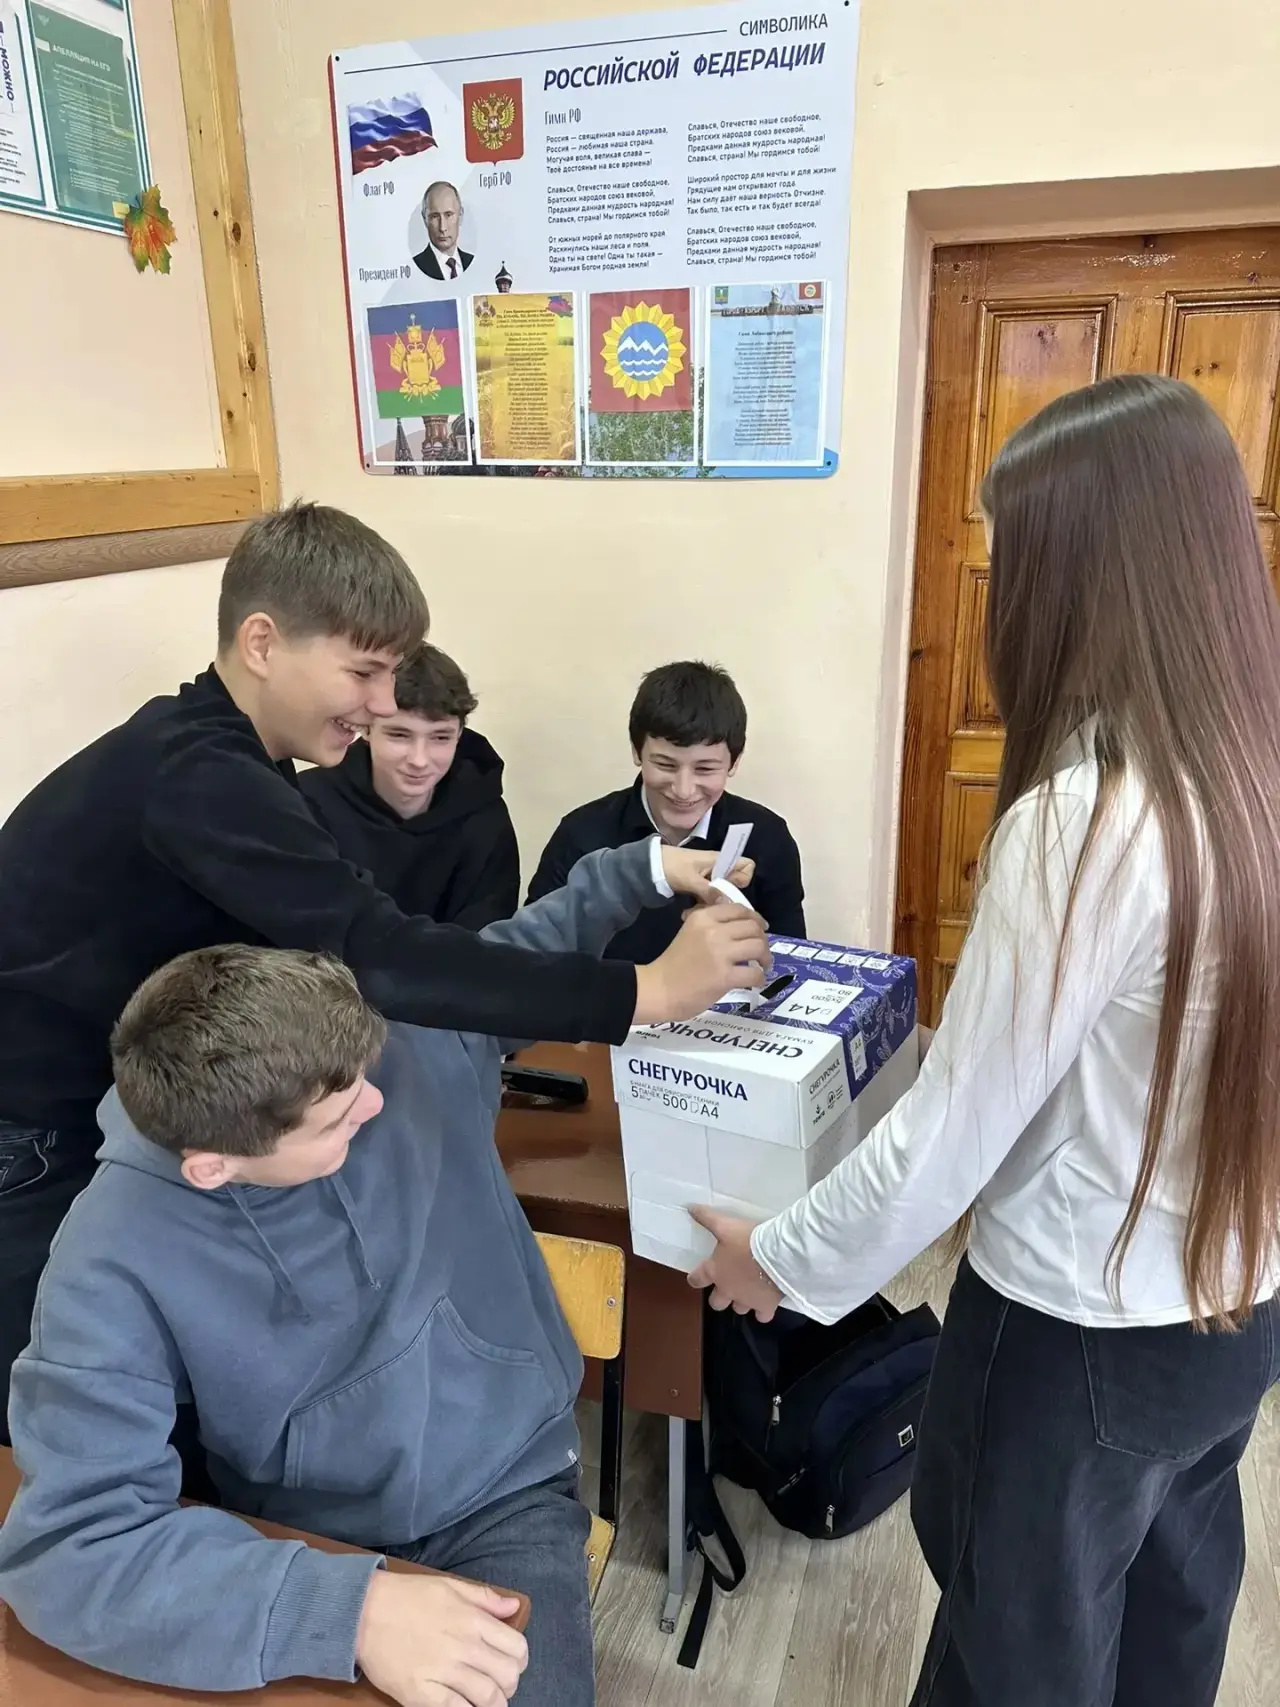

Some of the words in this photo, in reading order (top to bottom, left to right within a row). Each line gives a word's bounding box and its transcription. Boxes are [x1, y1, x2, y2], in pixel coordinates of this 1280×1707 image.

[740, 13, 829, 36] СИМВОЛИКА
[543, 50, 680, 91] РОССИЙСКОЙ
[693, 42, 826, 77] ФЕДЕРАЦИИ
[544, 111, 566, 125] Гимн
[569, 108, 581, 123] РФ
[479, 172, 498, 189] Герб
[500, 171, 512, 186] РФ
[363, 183, 381, 197] Флаг
[383, 181, 395, 195] РФ
[359, 267, 398, 282] Президент
[400, 265, 411, 279] РФ
[704, 1020, 751, 1033] ОФИСНОЙ
[752, 1028, 773, 1037] ДЛЯ
[775, 1033, 814, 1045] БУМАГА
[628, 1058, 748, 1101] СНЕГУРОЧКА
[631, 1085, 639, 1098] 5
[639, 1088, 660, 1098] ПАЧЕК
[662, 1094, 688, 1111] 500
[700, 1103, 719, 1119] A4
